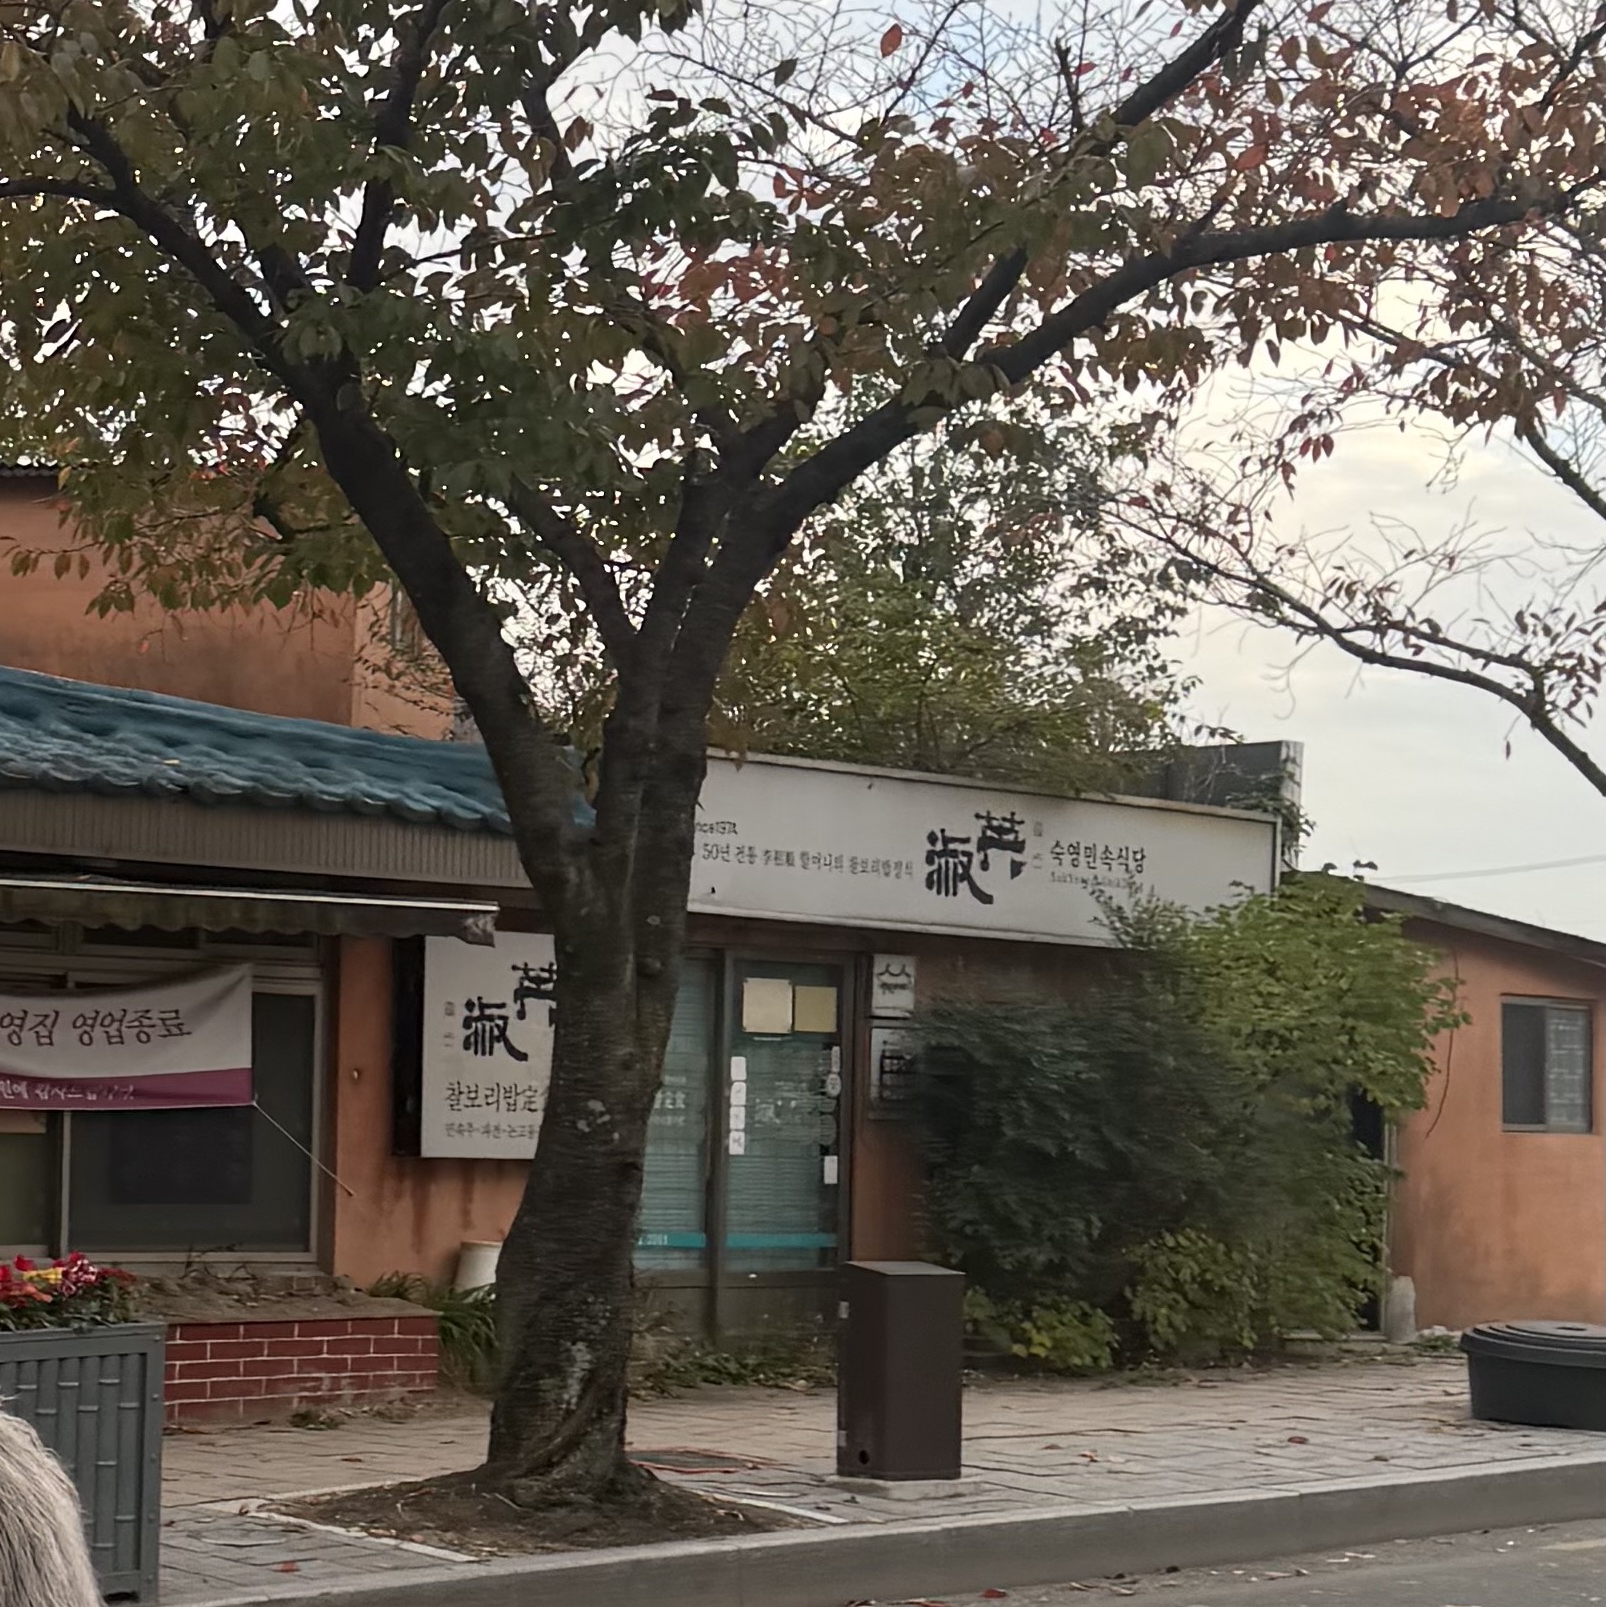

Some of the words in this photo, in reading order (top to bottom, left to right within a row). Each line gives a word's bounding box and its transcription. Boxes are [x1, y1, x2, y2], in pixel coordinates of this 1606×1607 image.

[702, 843, 731, 862] 50년
[1049, 839, 1147, 875] 숙영민속식당
[71, 1008, 193, 1047] 영업종료
